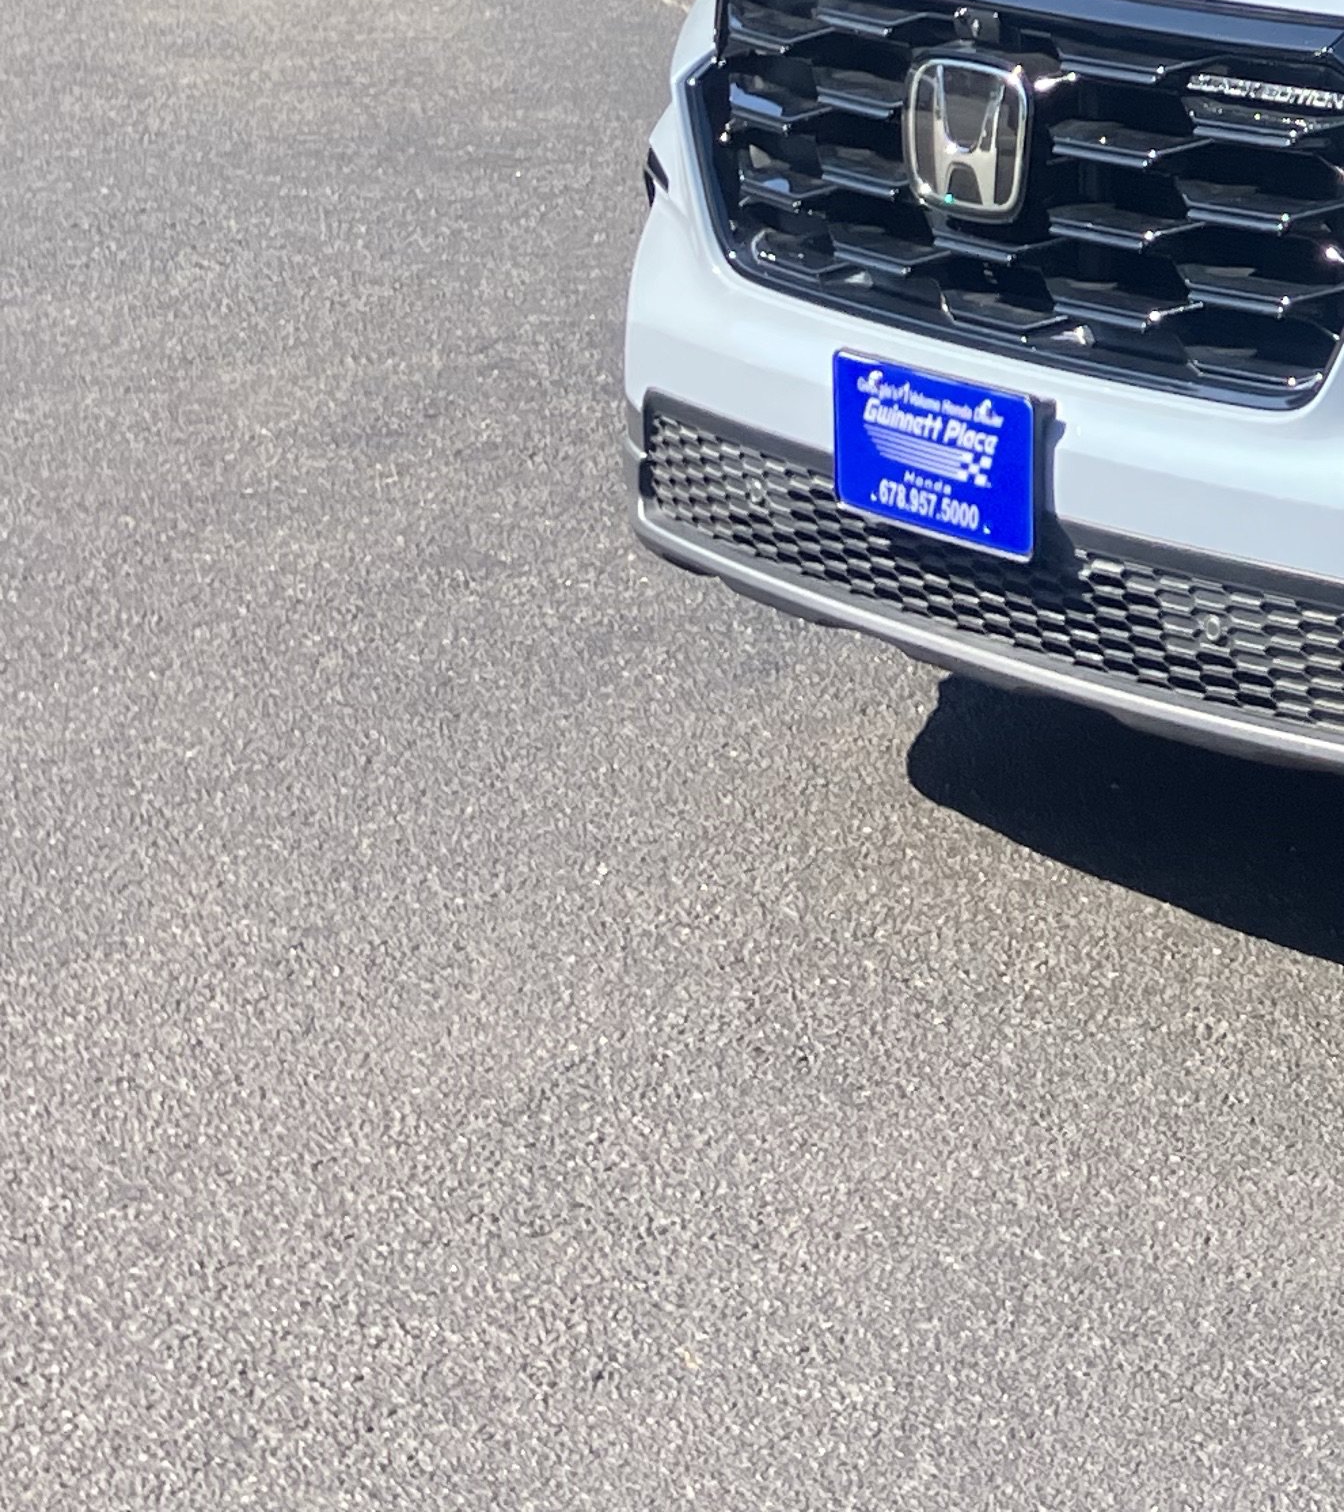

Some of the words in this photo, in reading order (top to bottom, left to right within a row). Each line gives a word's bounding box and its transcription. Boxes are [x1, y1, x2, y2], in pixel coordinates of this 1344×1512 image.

[863, 397, 943, 441] Gwinnett
[943, 418, 998, 455] Place
[879, 478, 979, 530] 678.957.5000
[904, 470, 951, 495] Honda
